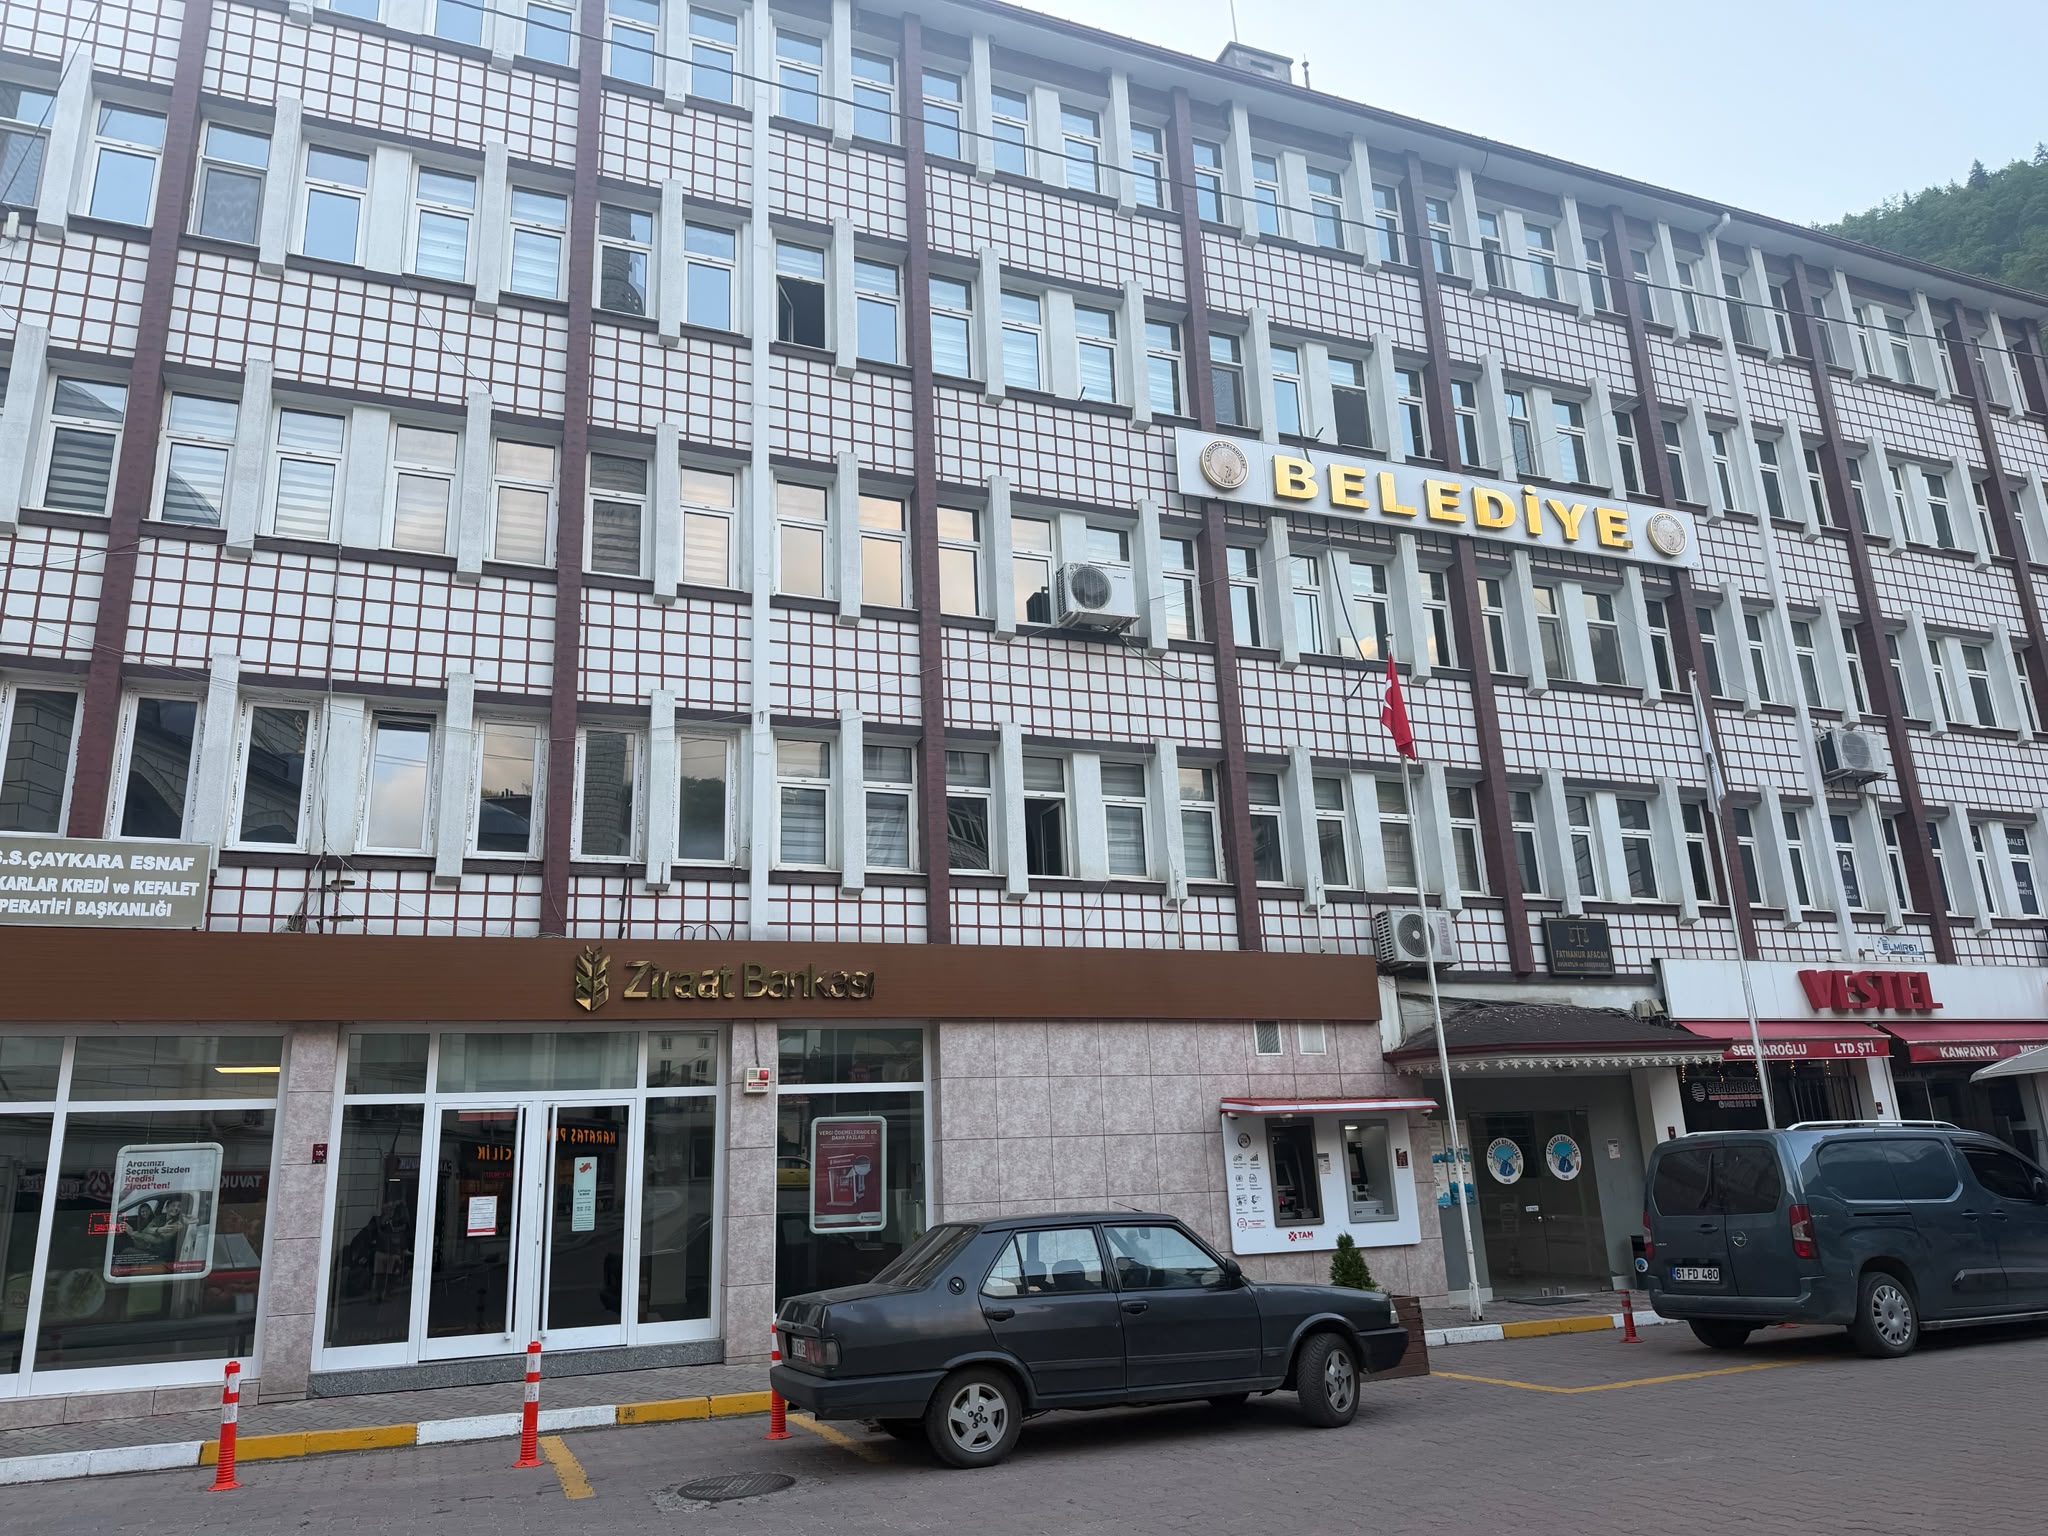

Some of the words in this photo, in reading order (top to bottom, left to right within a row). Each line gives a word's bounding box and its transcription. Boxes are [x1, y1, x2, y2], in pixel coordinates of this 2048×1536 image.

[1272, 454, 1634, 549] BELEDİYE
[0, 850, 124, 870] .S.ÇAYKARA
[130, 855, 195, 872] ESNAF
[61, 876, 110, 894] KREDİ
[113, 884, 130, 895] ve
[133, 880, 200, 896] KEFALET
[0, 897, 71, 915] PERATİFİ
[75, 900, 172, 918] BAŞKANLIĞI
[623, 960, 735, 999] Ziraat
[743, 961, 875, 999] Bankası
[1798, 970, 1943, 1010] VESTEL
[1732, 1042, 1807, 1056] SERAROĞLU
[1835, 1040, 1877, 1055] LTD.ŞTİ.
[1940, 1046, 1998, 1058] KAMPANYA
[125, 1175, 155, 1183] Kredisi
[126, 1167, 159, 1175] Seçmek
[161, 1166, 190, 1174] Sizden
[1298, 1231, 1313, 1239] TAM
[1676, 1268, 1685, 1279] 61
[1688, 1269, 1698, 1279] FD
[1702, 1269, 1718, 1280] 480
